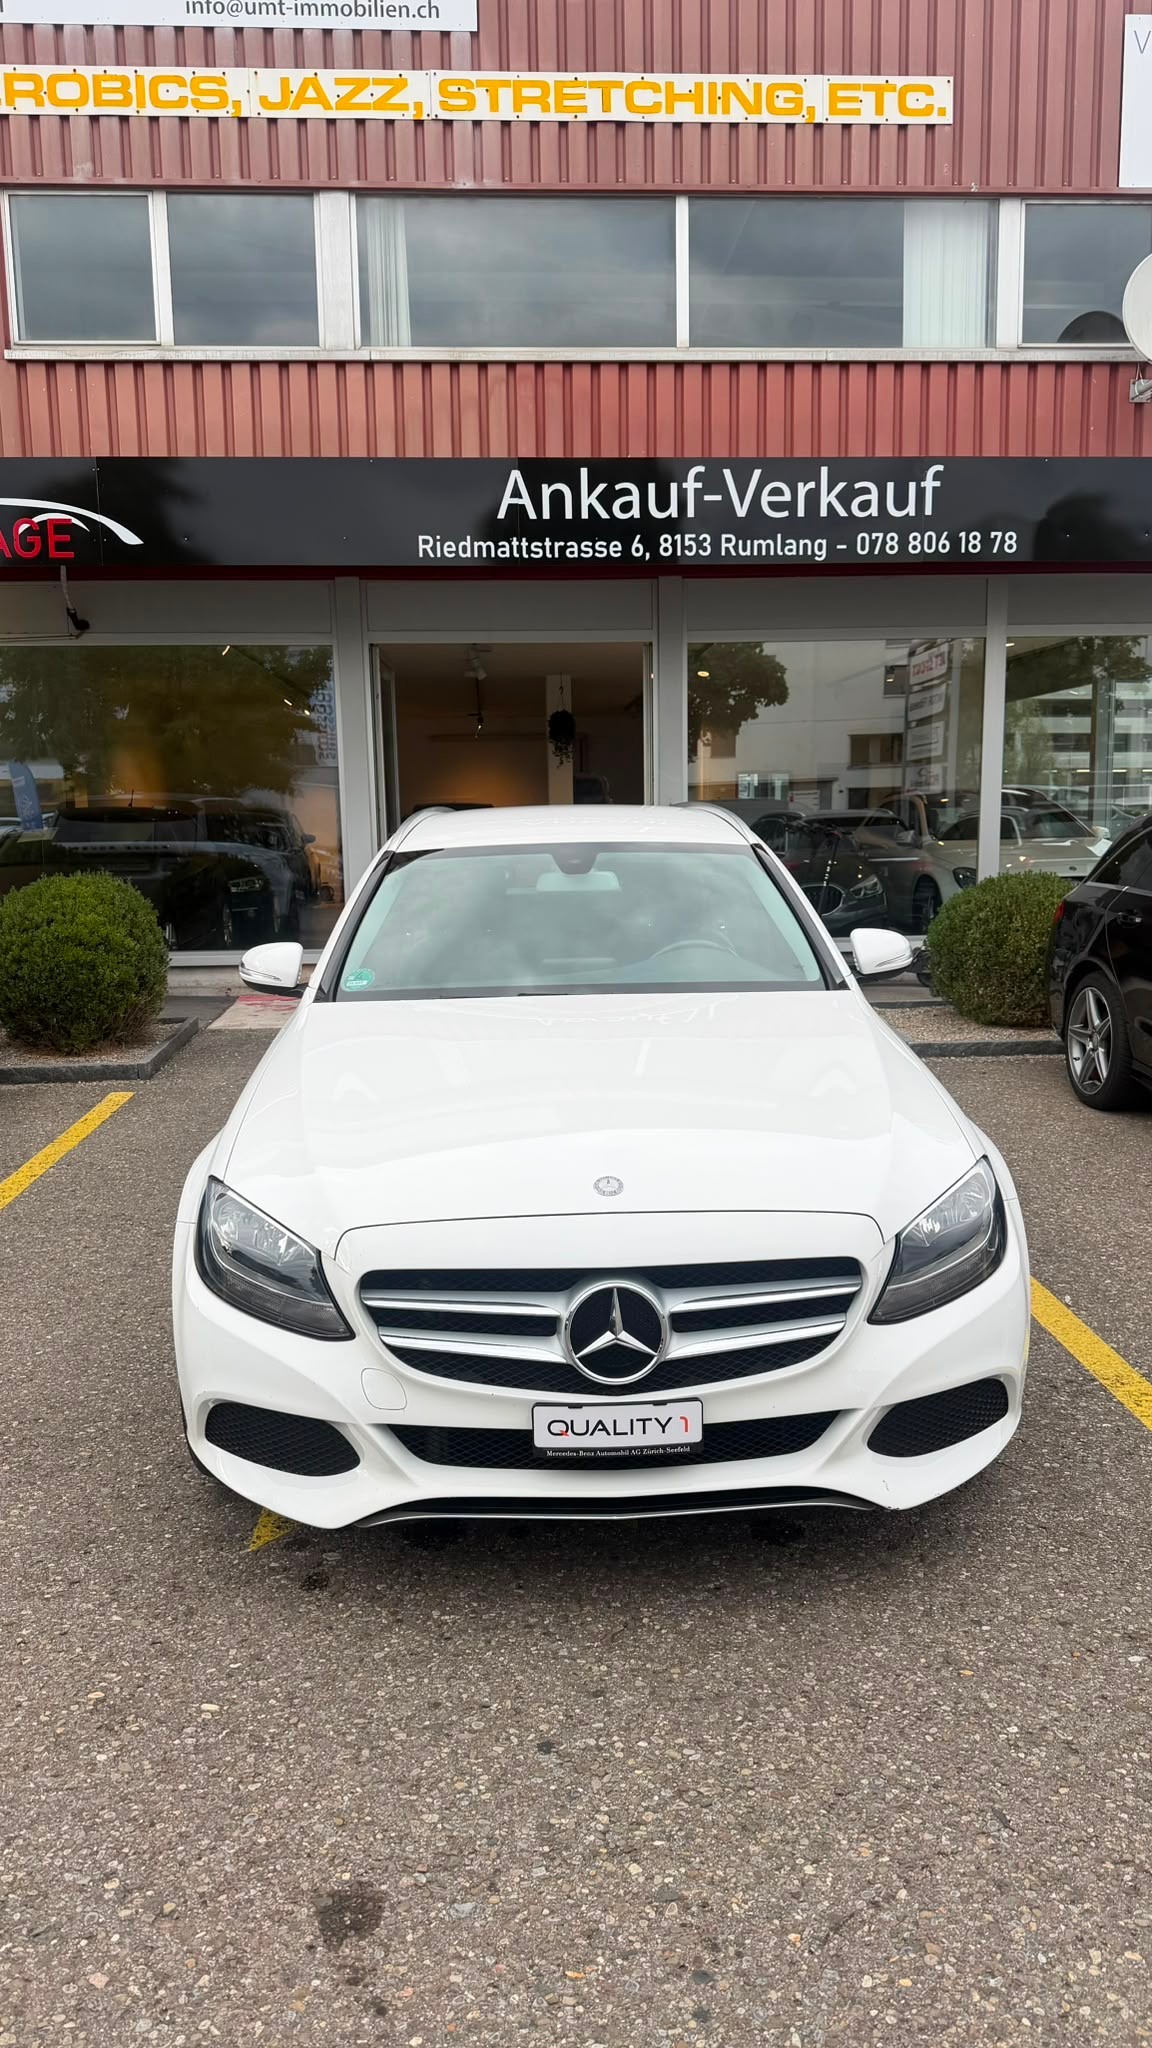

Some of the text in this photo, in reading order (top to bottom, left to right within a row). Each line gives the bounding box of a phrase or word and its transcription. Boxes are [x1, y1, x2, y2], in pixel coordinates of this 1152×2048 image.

[186, 0, 440, 18] info@umt-immobilien.ch
[0, 73, 947, 124] ROBICS, JAZZ, STRETCHING, ETC.
[496, 464, 945, 520] Ankauf-Verkauf
[417, 534, 623, 559] Riedmattstrasse
[631, 534, 650, 561] 6,
[659, 533, 712, 557] 8153
[720, 533, 827, 562] Rumlang
[856, 532, 899, 556] 078
[907, 530, 951, 555] 806
[958, 530, 982, 554] 18
[990, 531, 1018, 554] 78
[547, 1415, 688, 1437] QUALITY 1
[546, 1449, 595, 1457] Mercedes-Benz
